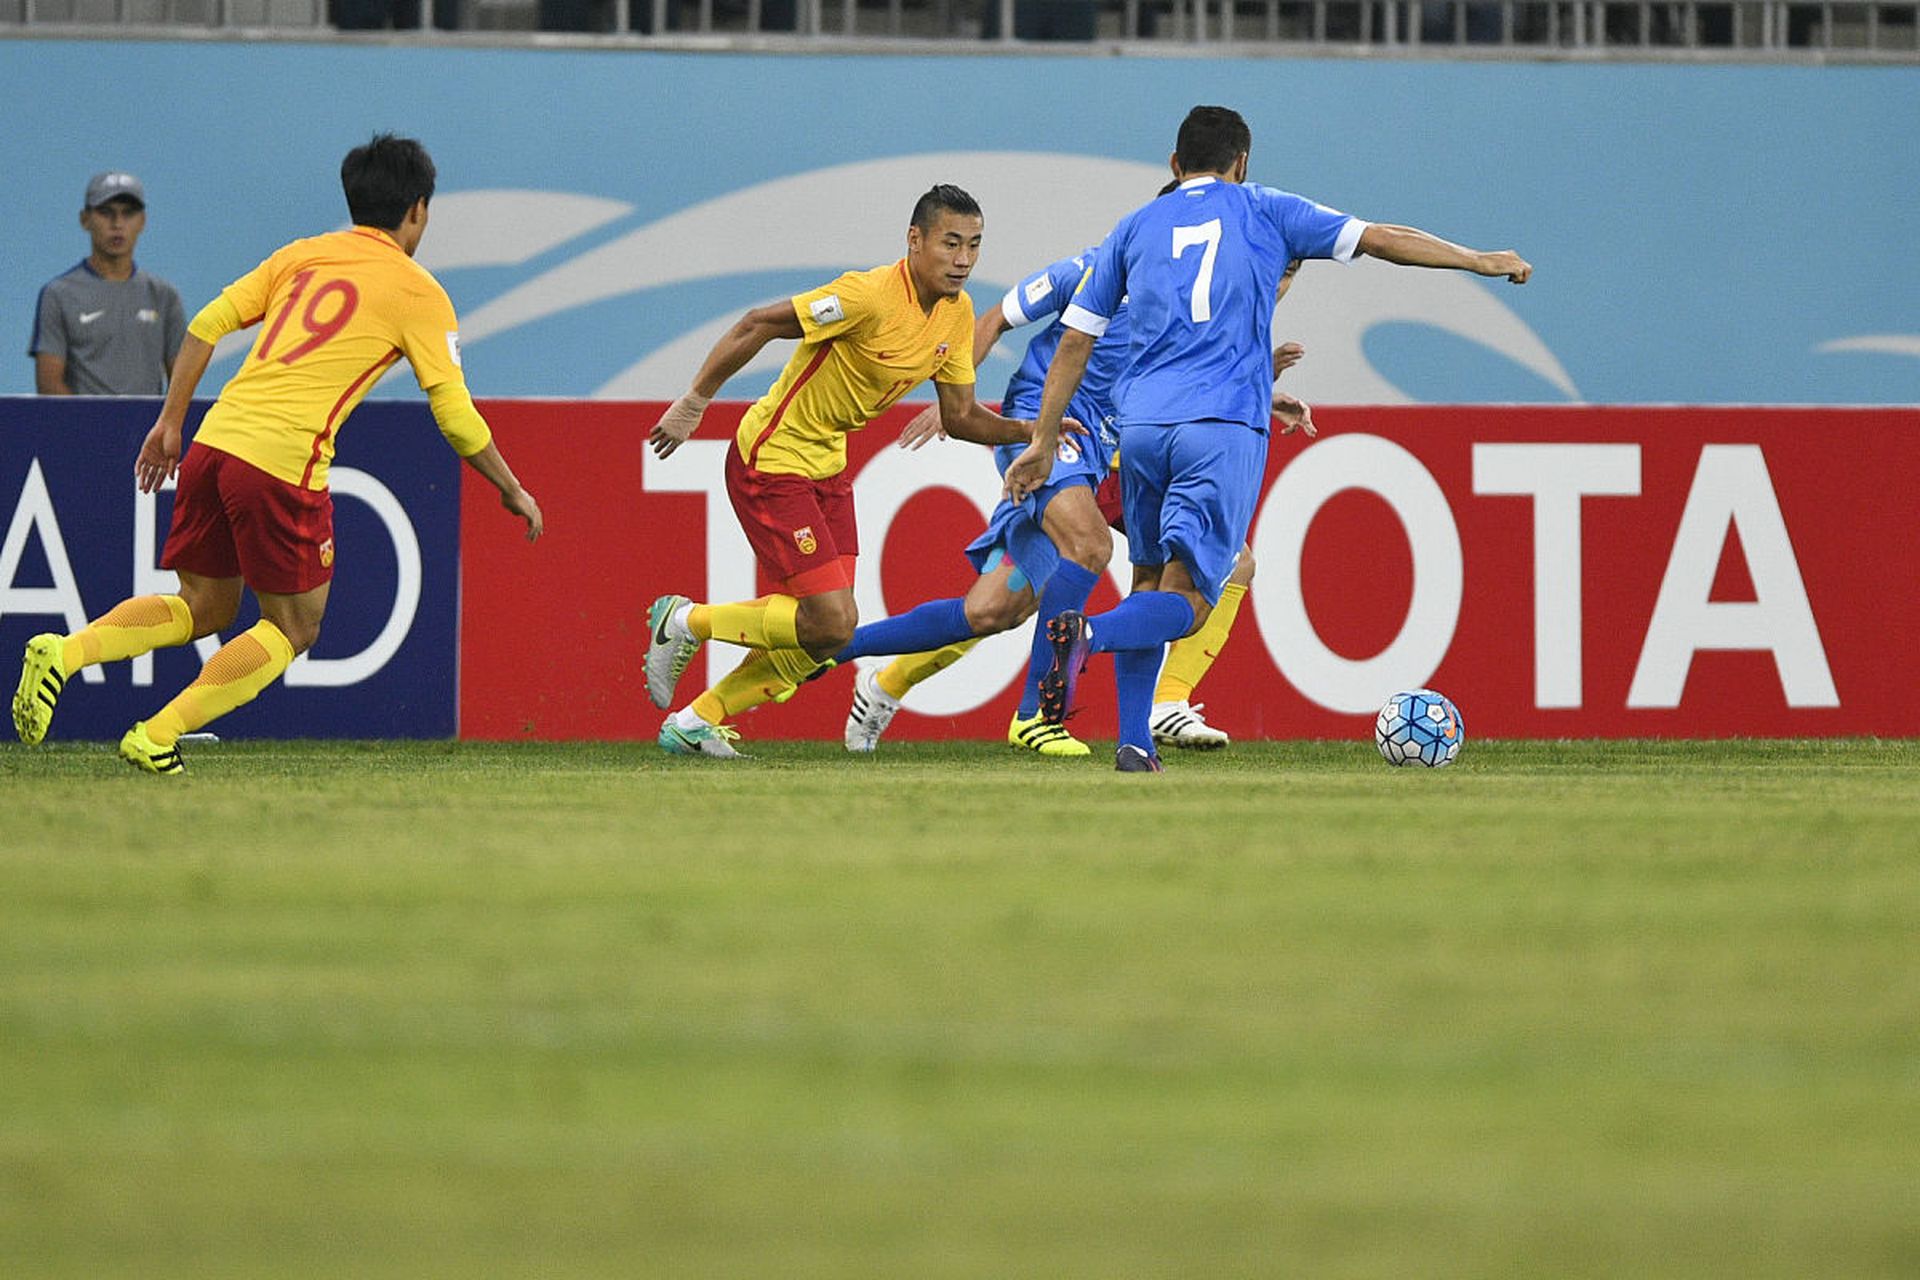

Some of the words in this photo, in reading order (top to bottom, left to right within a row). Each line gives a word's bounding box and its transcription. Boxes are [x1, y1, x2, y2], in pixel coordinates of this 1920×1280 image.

[257, 269, 359, 365] 19
[1171, 217, 1222, 322] 7
[642, 433, 1840, 714] TOOTA
